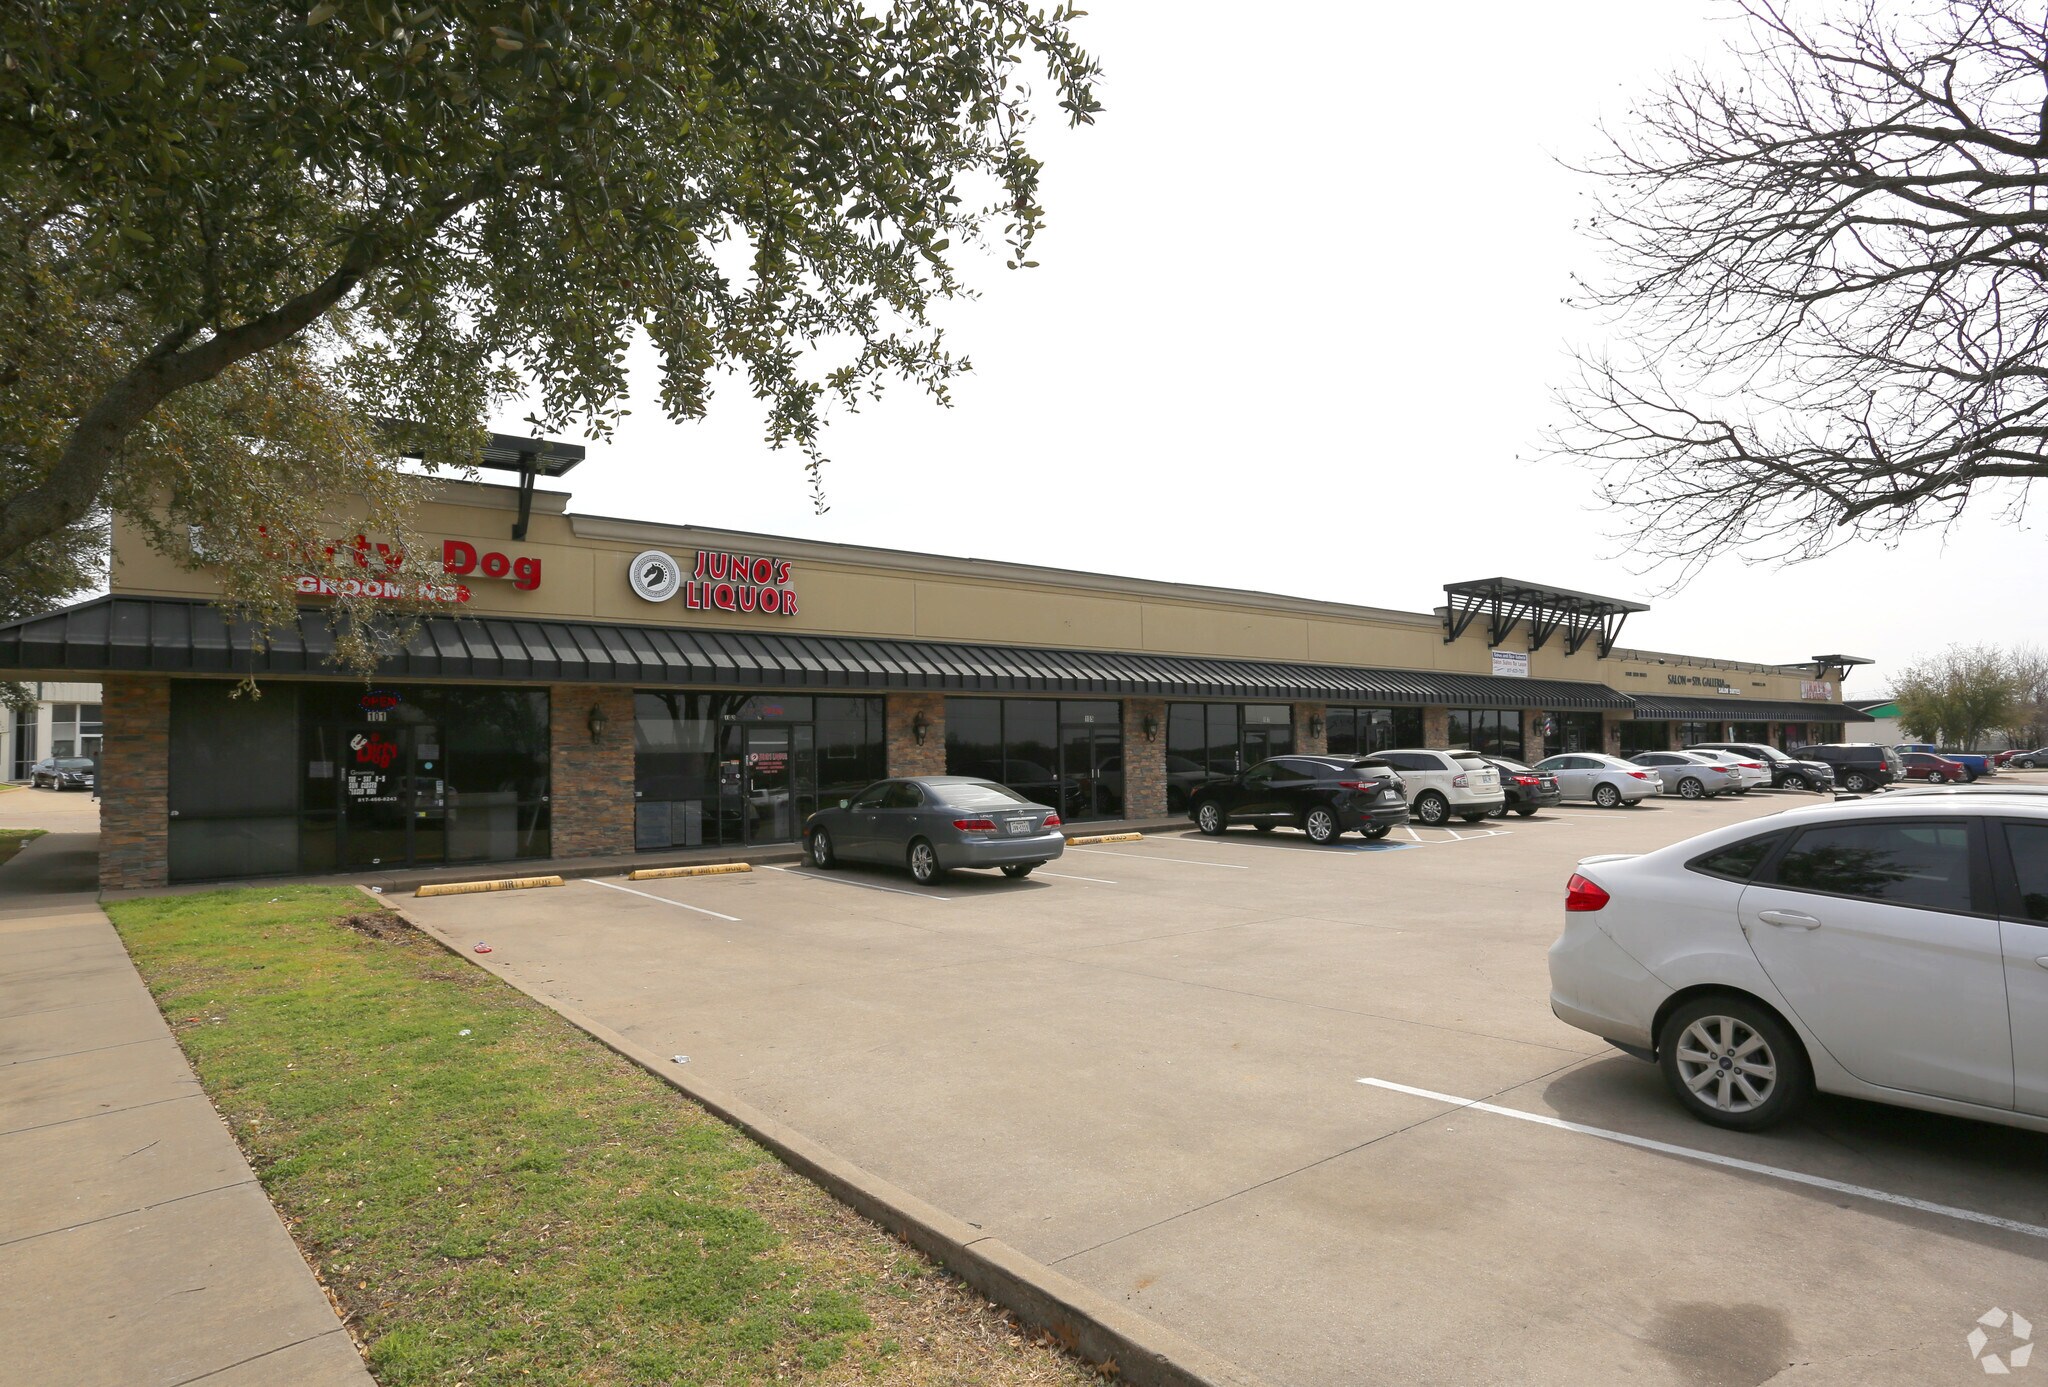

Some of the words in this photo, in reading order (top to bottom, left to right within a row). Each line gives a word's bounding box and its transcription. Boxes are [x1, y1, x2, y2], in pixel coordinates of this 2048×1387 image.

[442, 539, 542, 591] Dog
[693, 550, 792, 585] JUNO'S
[686, 580, 799, 616] LIQUOR
[1668, 674, 1687, 685] SALON
[1692, 676, 1701, 686] SPA
[1702, 677, 1724, 688] GALLERIA
[361, 695, 398, 707] OPEN
[368, 712, 386, 721] 101
